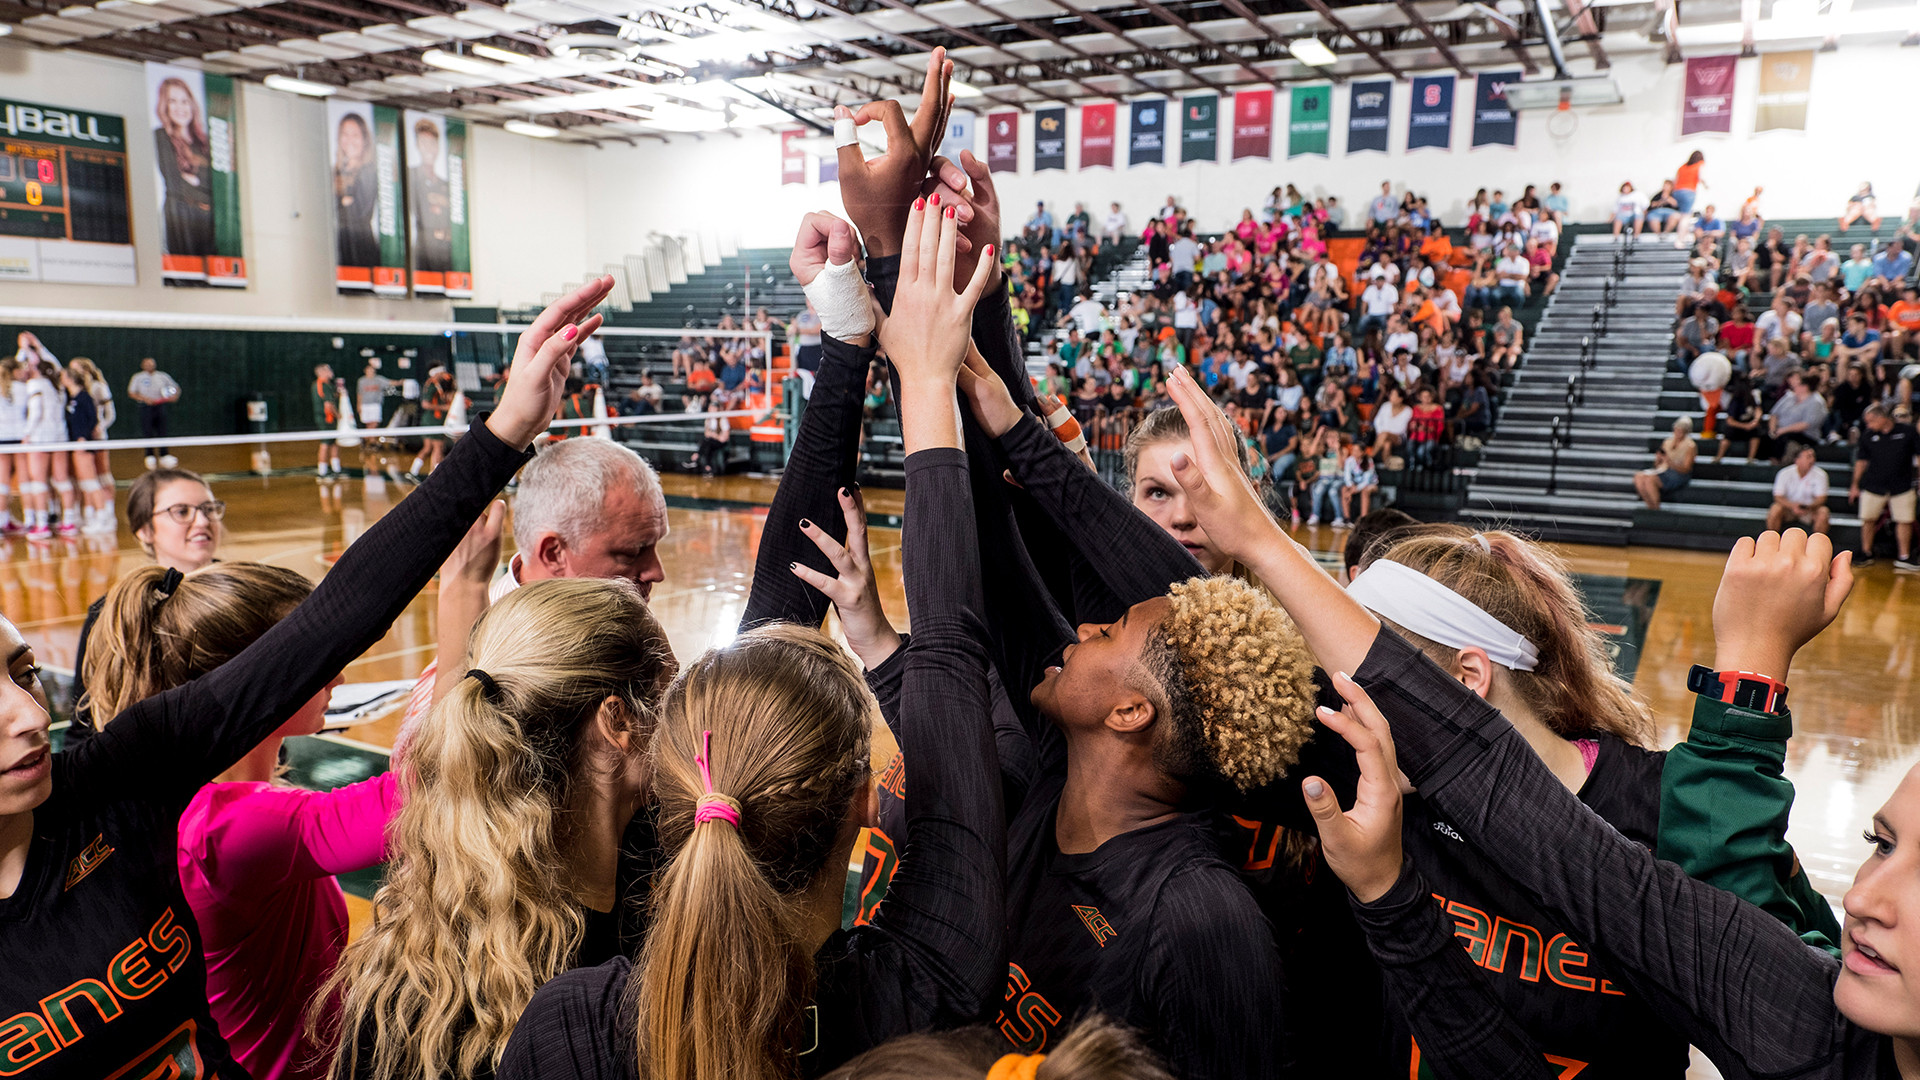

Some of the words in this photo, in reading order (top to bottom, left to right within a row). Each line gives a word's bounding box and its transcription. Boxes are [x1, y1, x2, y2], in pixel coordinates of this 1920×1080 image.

[65, 833, 115, 892] ACC
[1071, 904, 1117, 947] ACC
[1432, 893, 1626, 996] ane
